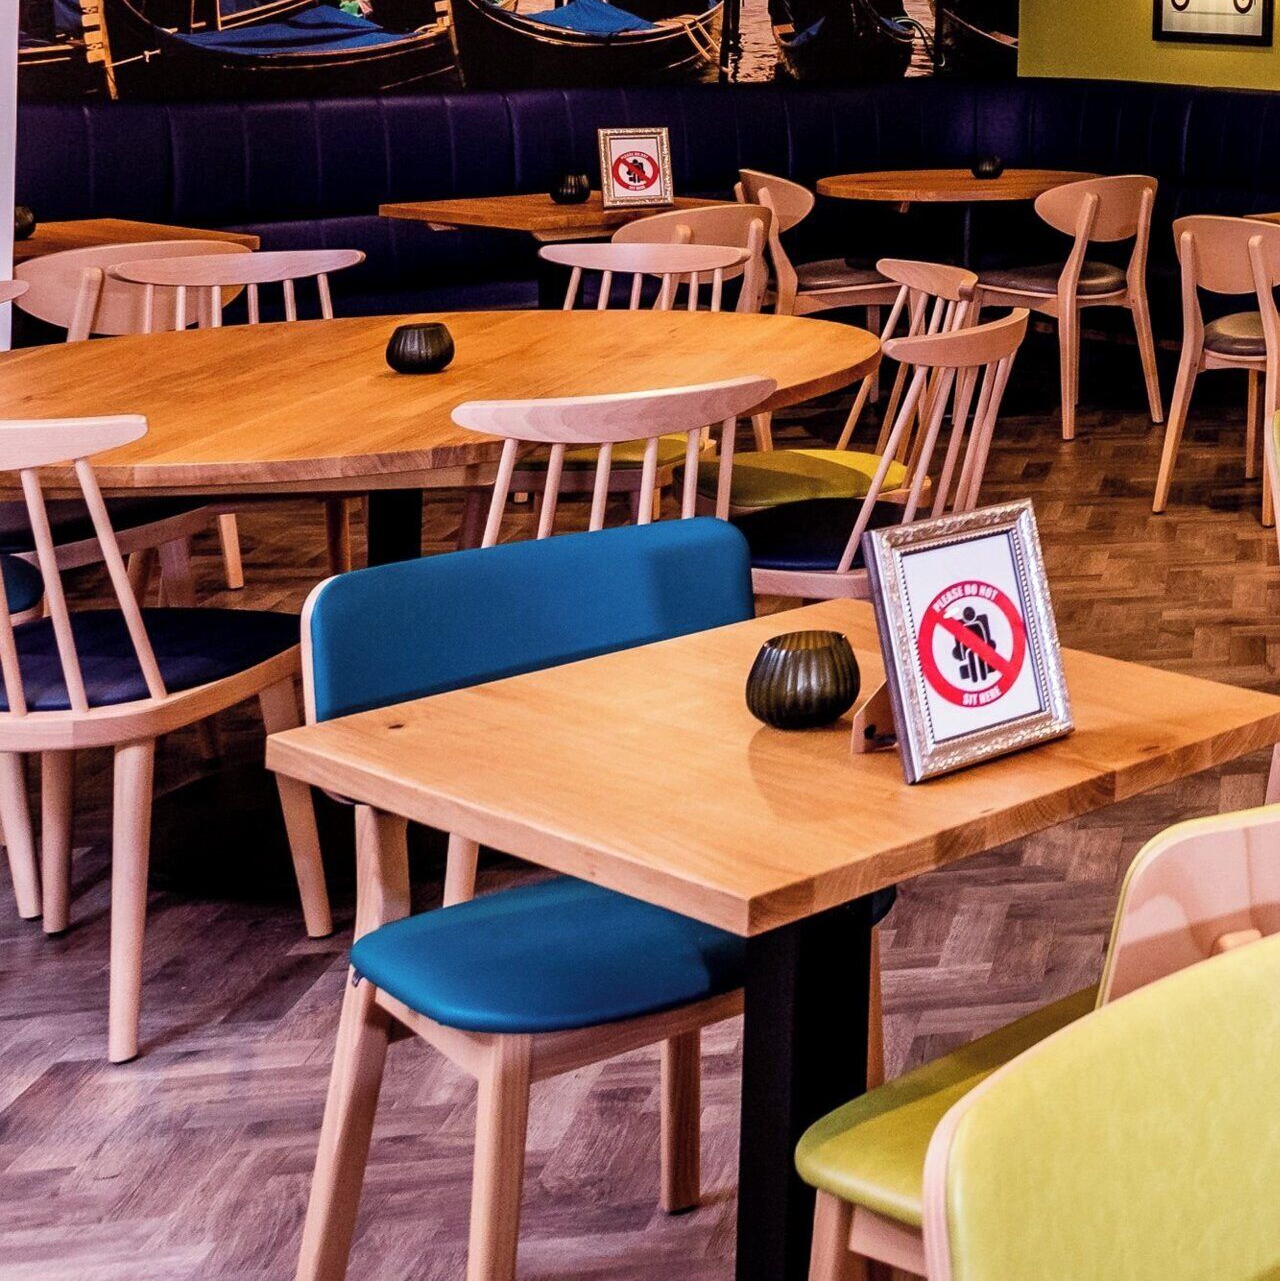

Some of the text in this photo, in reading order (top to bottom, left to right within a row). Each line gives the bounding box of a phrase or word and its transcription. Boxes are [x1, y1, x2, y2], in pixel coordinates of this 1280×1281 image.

[933, 584, 998, 613] PLEASE DO NOT
[962, 686, 1002, 706] SIT HERE
